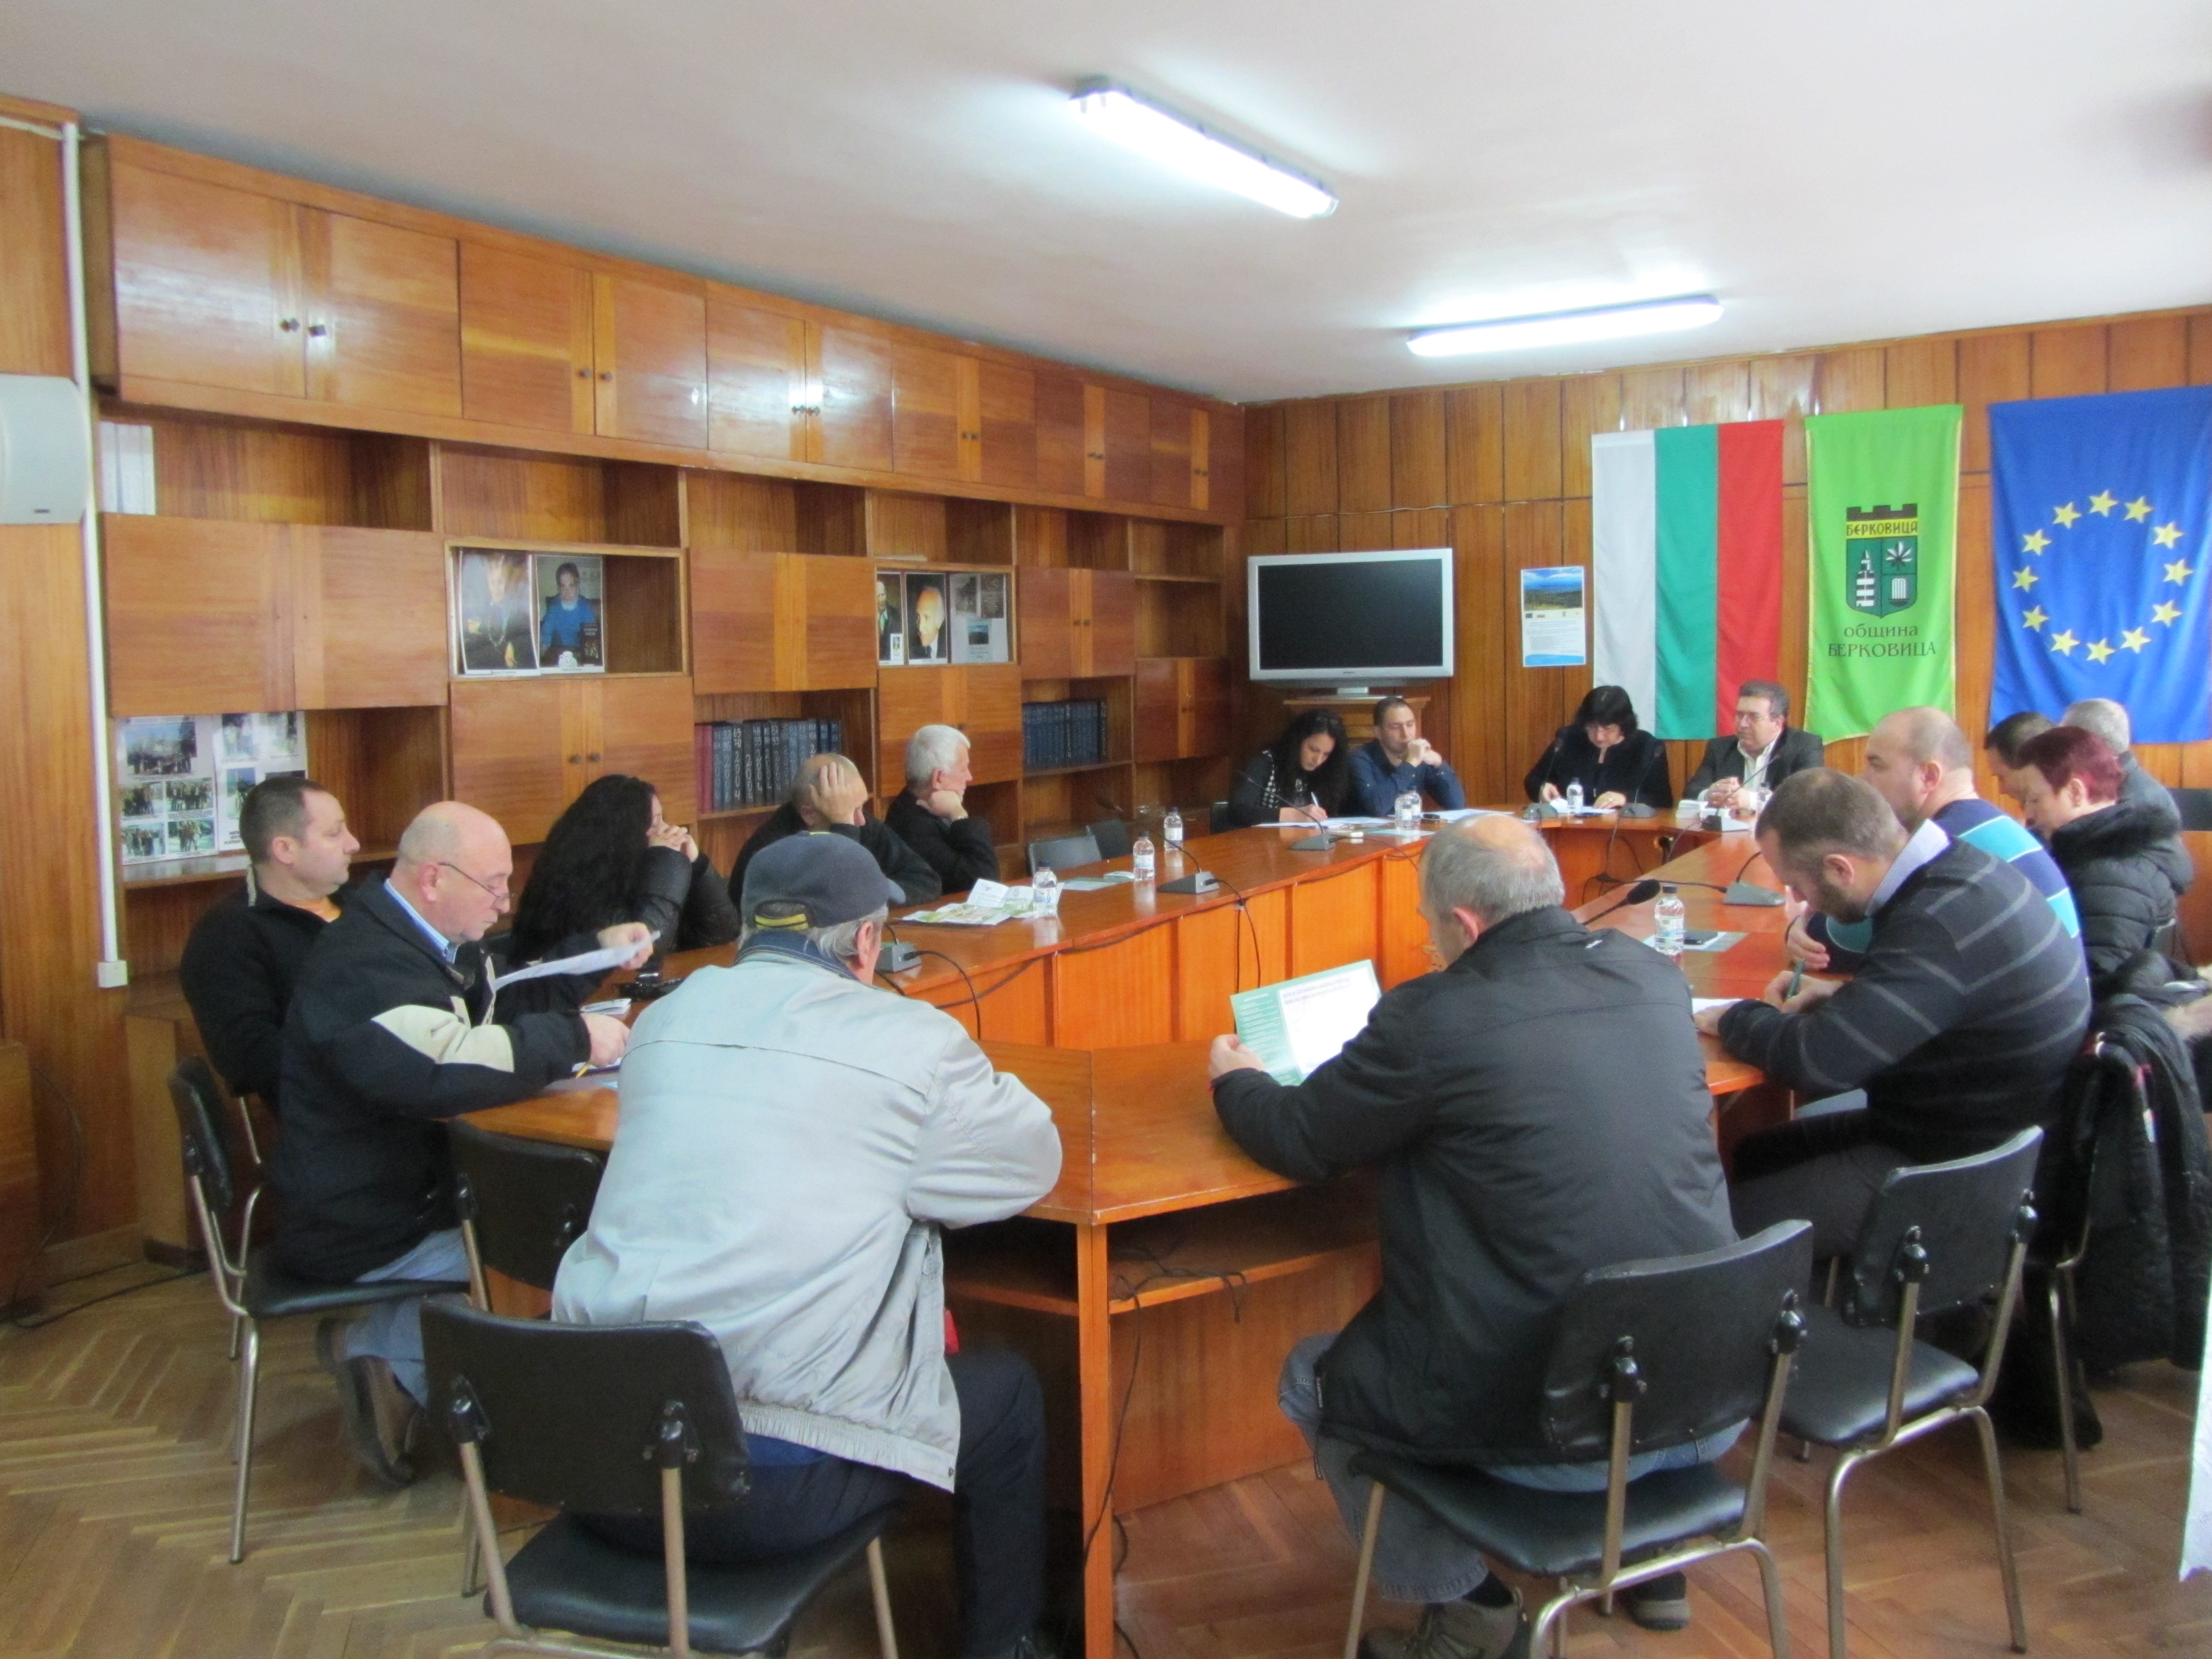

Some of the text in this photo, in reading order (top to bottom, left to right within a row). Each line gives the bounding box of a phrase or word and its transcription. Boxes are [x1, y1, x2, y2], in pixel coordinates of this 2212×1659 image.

[1846, 521, 1917, 536] БЕРКОВИЦА
[1844, 623, 1918, 638] община
[1828, 641, 1936, 657] БЕРКОВИЦА
[745, 754, 753, 802] 2004
